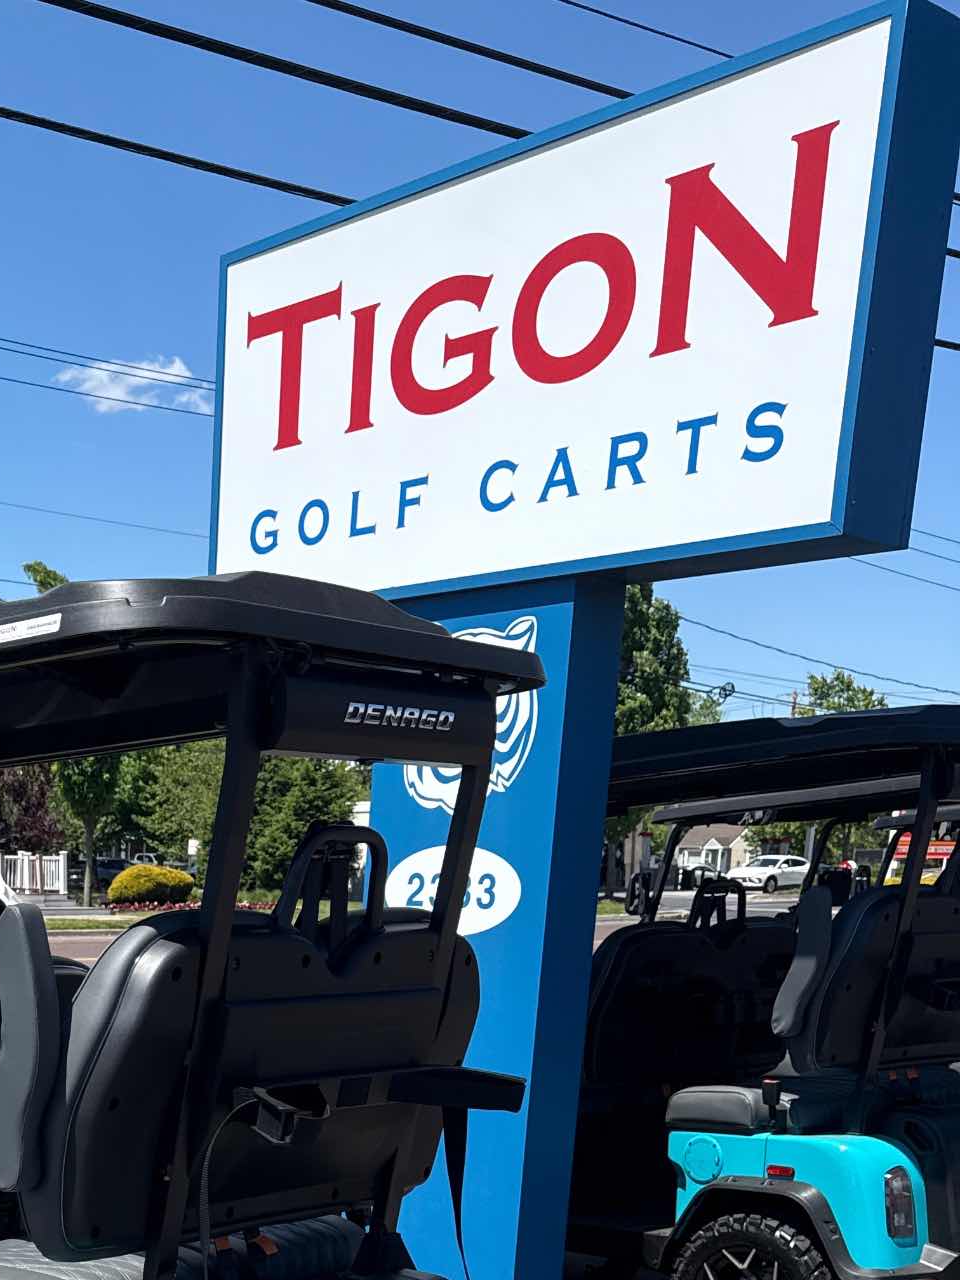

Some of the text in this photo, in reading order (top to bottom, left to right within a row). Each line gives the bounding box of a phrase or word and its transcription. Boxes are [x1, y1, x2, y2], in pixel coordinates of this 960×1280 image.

[247, 120, 839, 451] TIGON
[250, 401, 788, 556] GOLF CARTS
[344, 702, 455, 731] DENAGO
